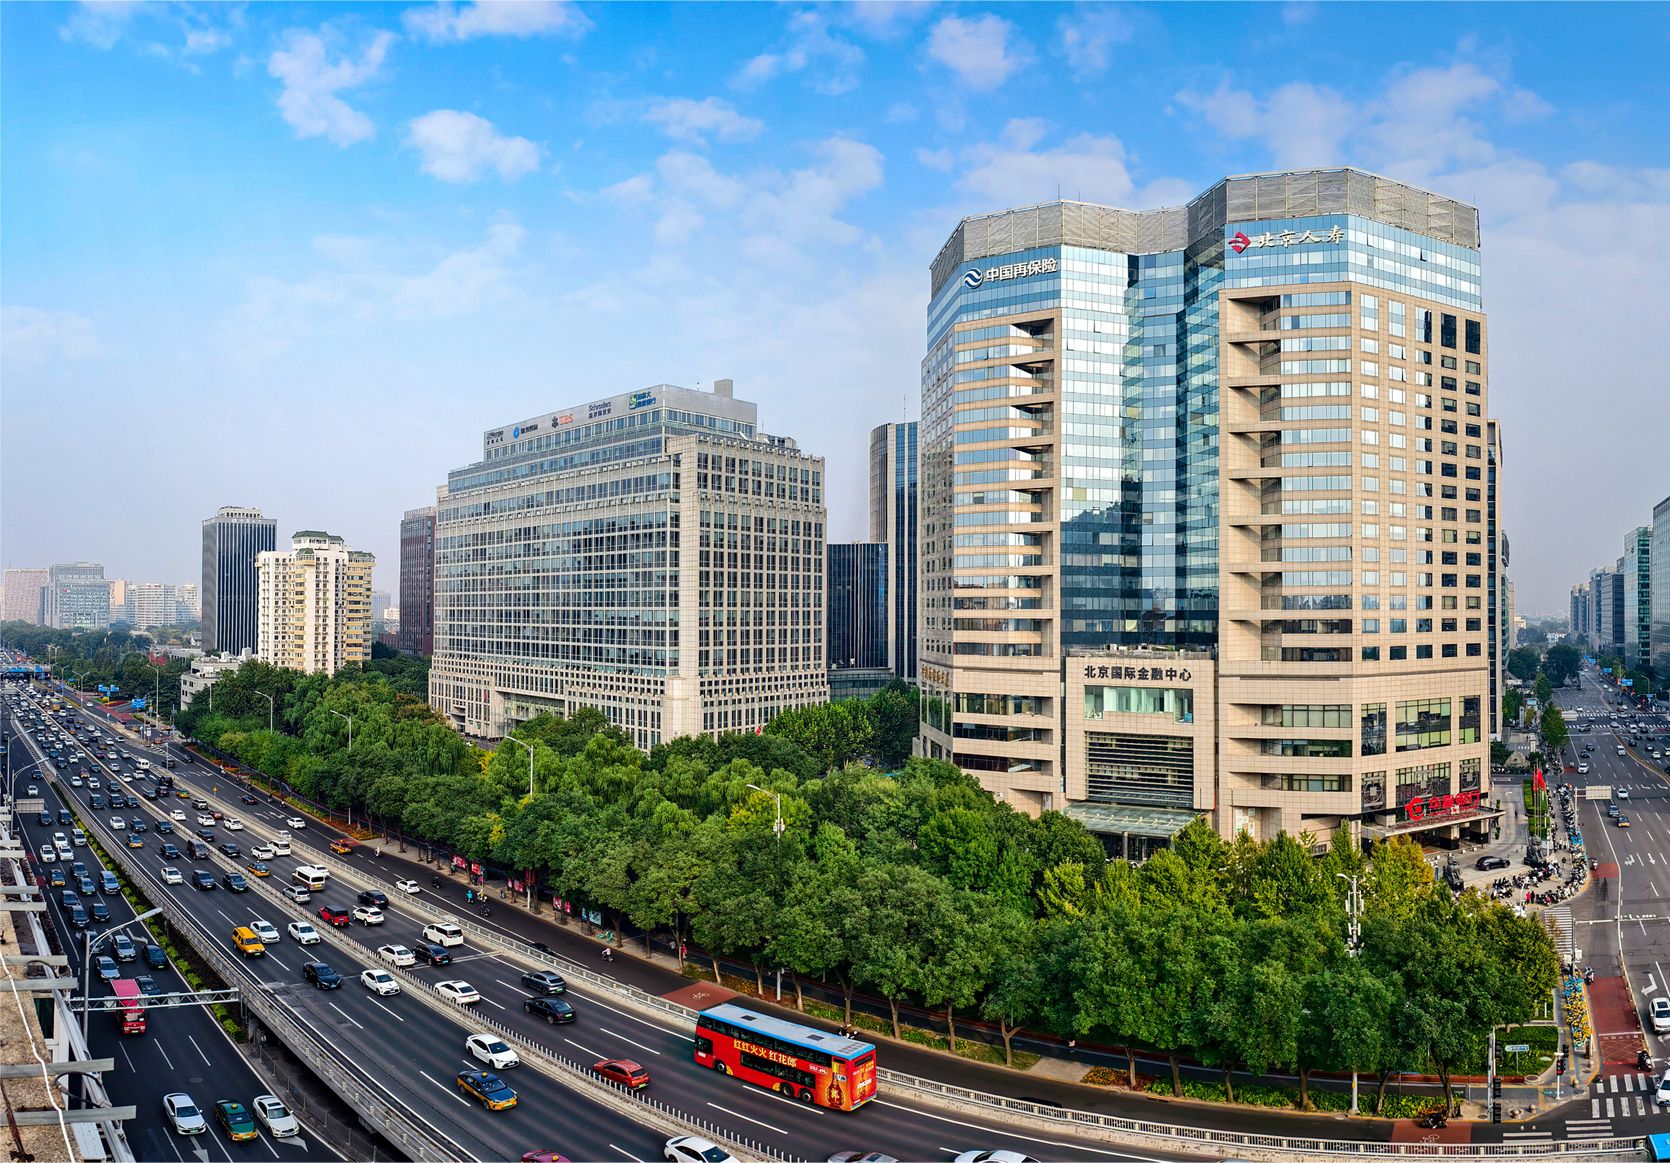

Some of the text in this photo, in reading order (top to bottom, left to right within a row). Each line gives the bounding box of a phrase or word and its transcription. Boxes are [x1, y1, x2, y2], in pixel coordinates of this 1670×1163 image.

[1258, 224, 1345, 248] 北京人寿
[986, 257, 1058, 282] 中国再保险
[1084, 665, 1192, 681] 北京国际金融中心
[733, 1039, 798, 1068] 红红火火 红花郎
